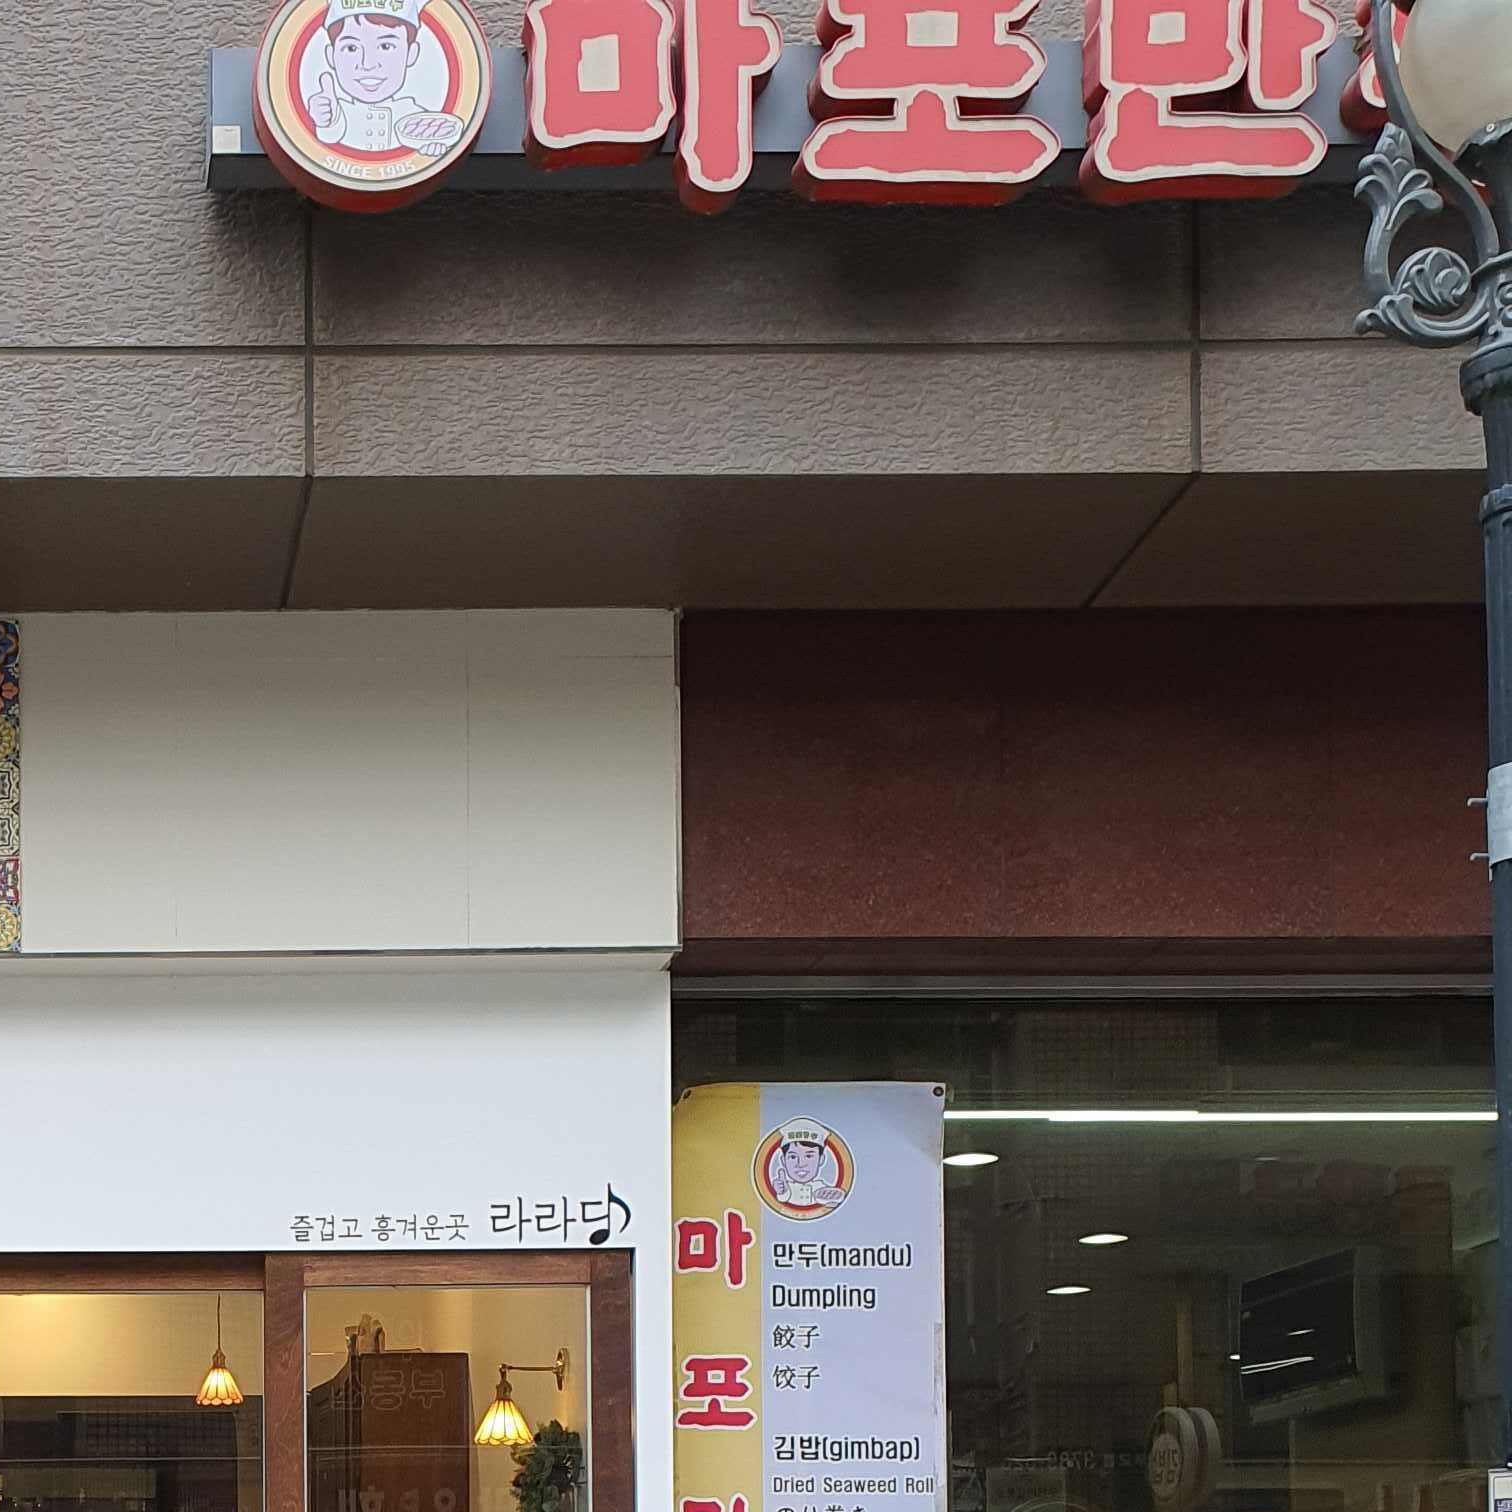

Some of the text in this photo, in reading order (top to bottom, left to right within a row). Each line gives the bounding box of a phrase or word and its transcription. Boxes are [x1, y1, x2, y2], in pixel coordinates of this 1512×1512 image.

[524, 0, 1393, 193] 마포만
[324, 156, 372, 177] SINCE
[289, 1214, 363, 1242] 즐겁고
[371, 1214, 470, 1242] 흥겨운곳
[773, 1242, 912, 1268] 만두(mandu)
[772, 1284, 876, 1309] Dumpling
[773, 1324, 819, 1349] 餃子
[773, 1364, 819, 1389] 饺子
[774, 1436, 920, 1461] 김밥(gimbap)
[773, 1477, 934, 1493] Dried Seaweed Roll
